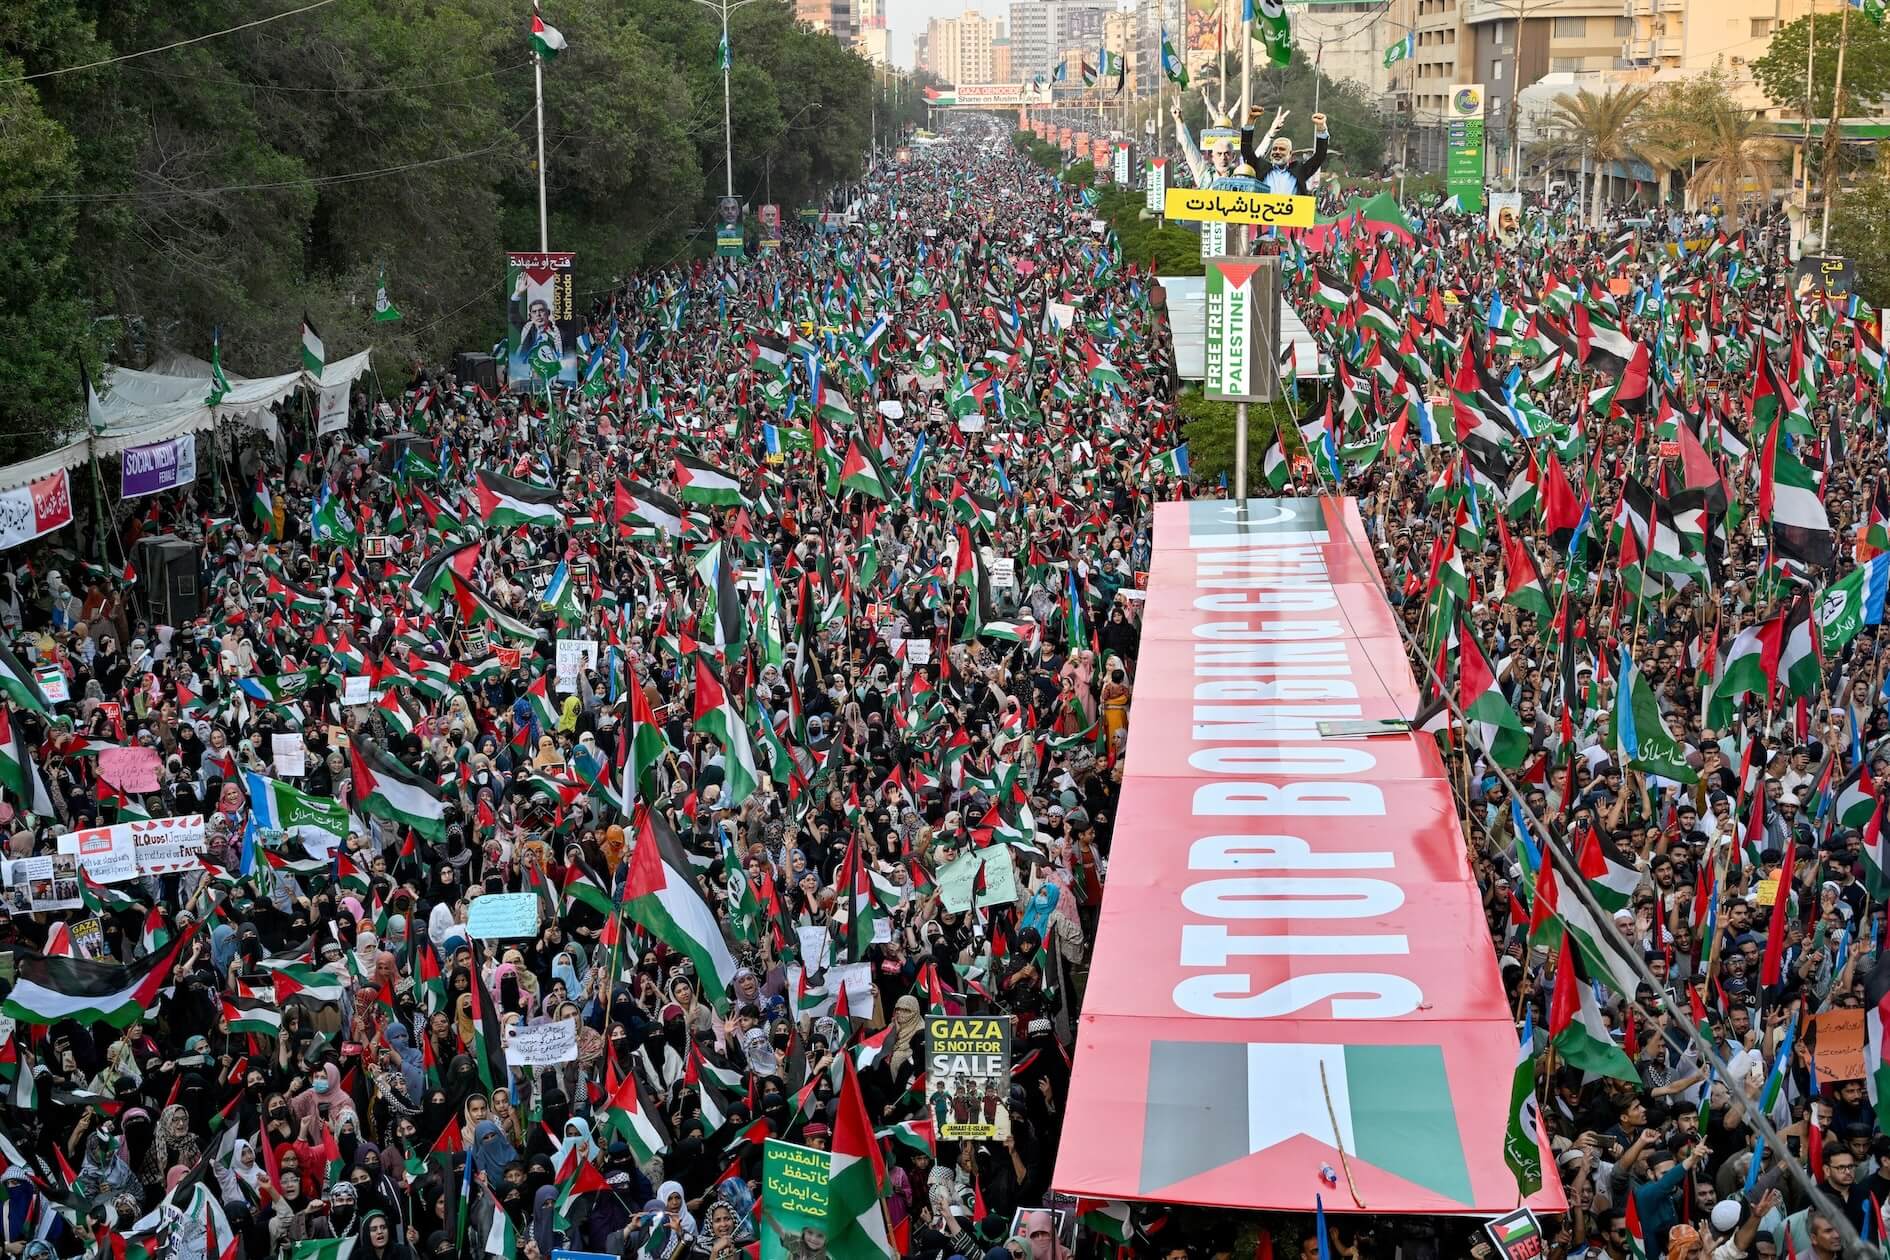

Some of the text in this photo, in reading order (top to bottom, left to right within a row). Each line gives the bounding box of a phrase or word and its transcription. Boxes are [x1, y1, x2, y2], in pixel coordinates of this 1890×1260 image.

[959, 87, 980, 95] GAZA
[1186, 196, 1248, 216] شہادت
[1262, 198, 1294, 221] فتح
[550, 257, 571, 270] فتح
[1821, 260, 1843, 273] فتح
[563, 274, 572, 320] Shahada
[1208, 293, 1222, 388] FREE FREE
[1230, 291, 1244, 394] PALESTINE
[126, 450, 153, 476] SOCIAL
[154, 445, 175, 470] MEDIA
[158, 468, 175, 484] FEMALE
[465, 640, 487, 651] FREE
[1172, 546, 1424, 1018] STOP BOMBING GAZA
[289, 807, 343, 831] جماعت اسلامی
[72, 921, 98, 934] GAZA
[76, 932, 101, 946] SALE
[931, 1019, 1003, 1039] GAZA
[934, 1041, 1000, 1052] IS NOT FOR
[933, 1055, 1002, 1077] SALE
[767, 1150, 819, 1167] المقدس
[782, 1164, 817, 1182] تحفظ
[1507, 1234, 1541, 1260] FREE
